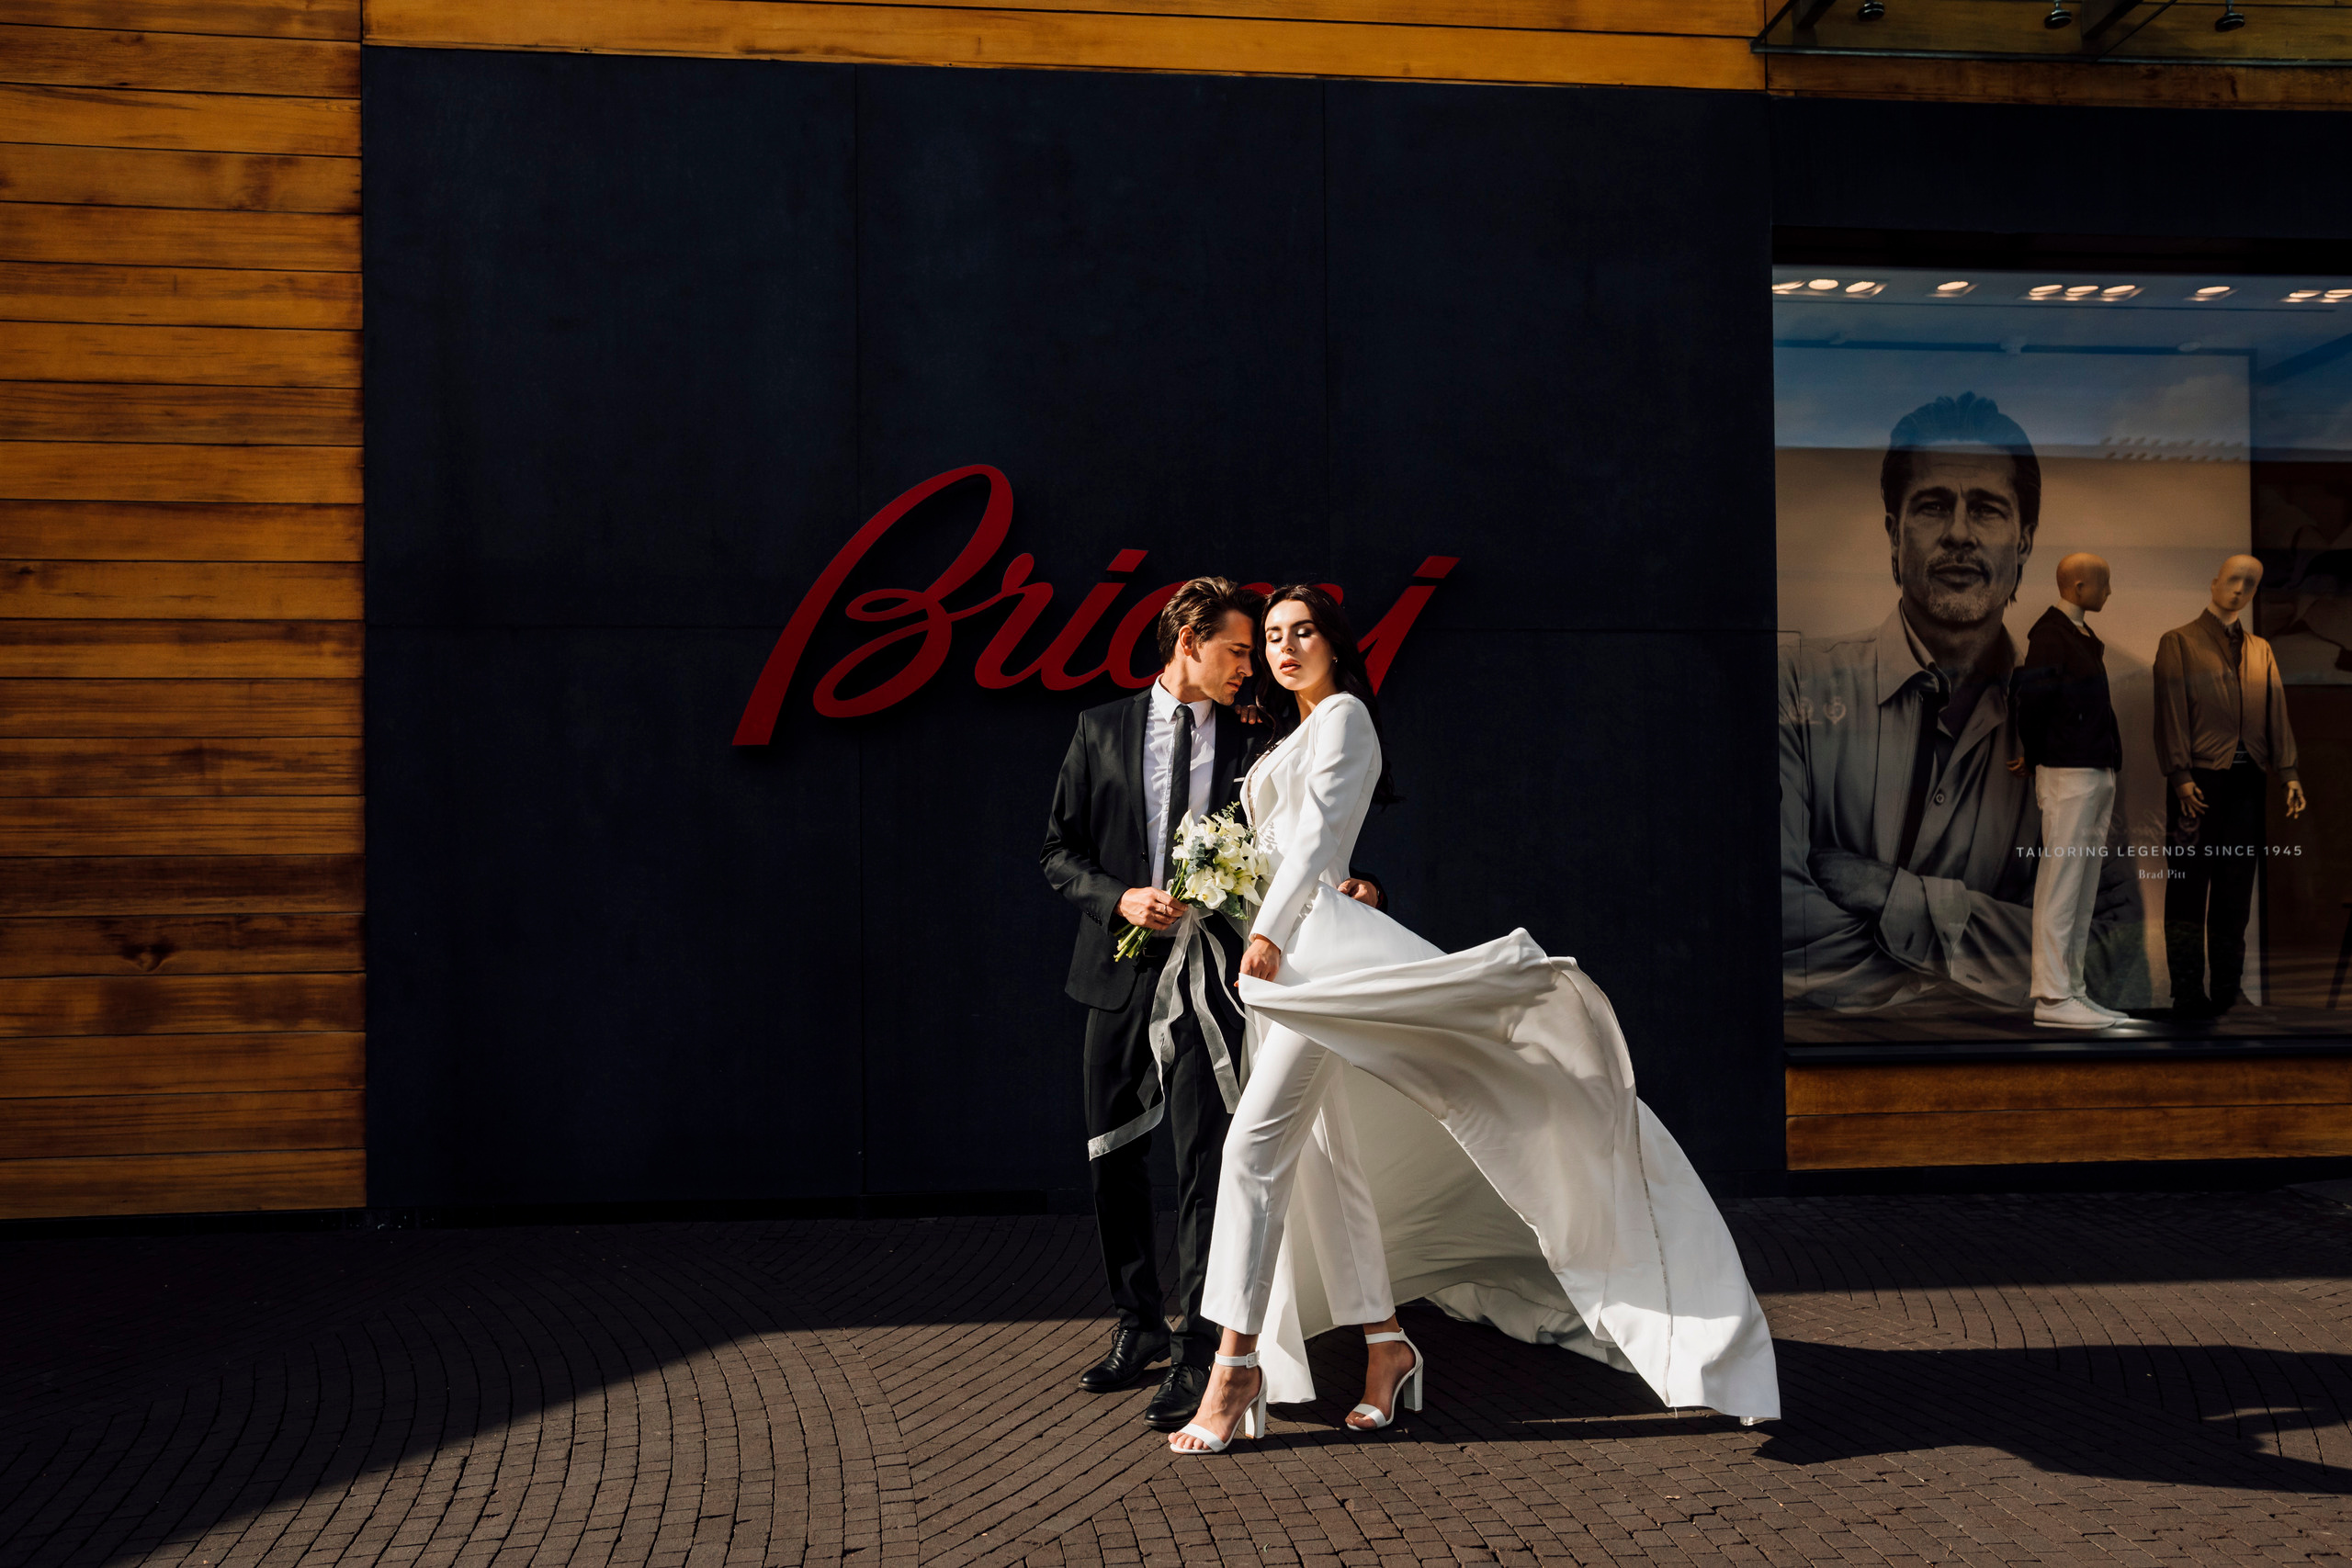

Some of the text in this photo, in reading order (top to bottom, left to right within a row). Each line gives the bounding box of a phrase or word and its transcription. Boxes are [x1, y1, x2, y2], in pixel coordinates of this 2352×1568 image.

[731, 464, 1461, 745] Brioi
[2016, 844, 2302, 858] TAILORING LEGENDS SINCE 1945
[2138, 868, 2186, 880] Brad Pitt
